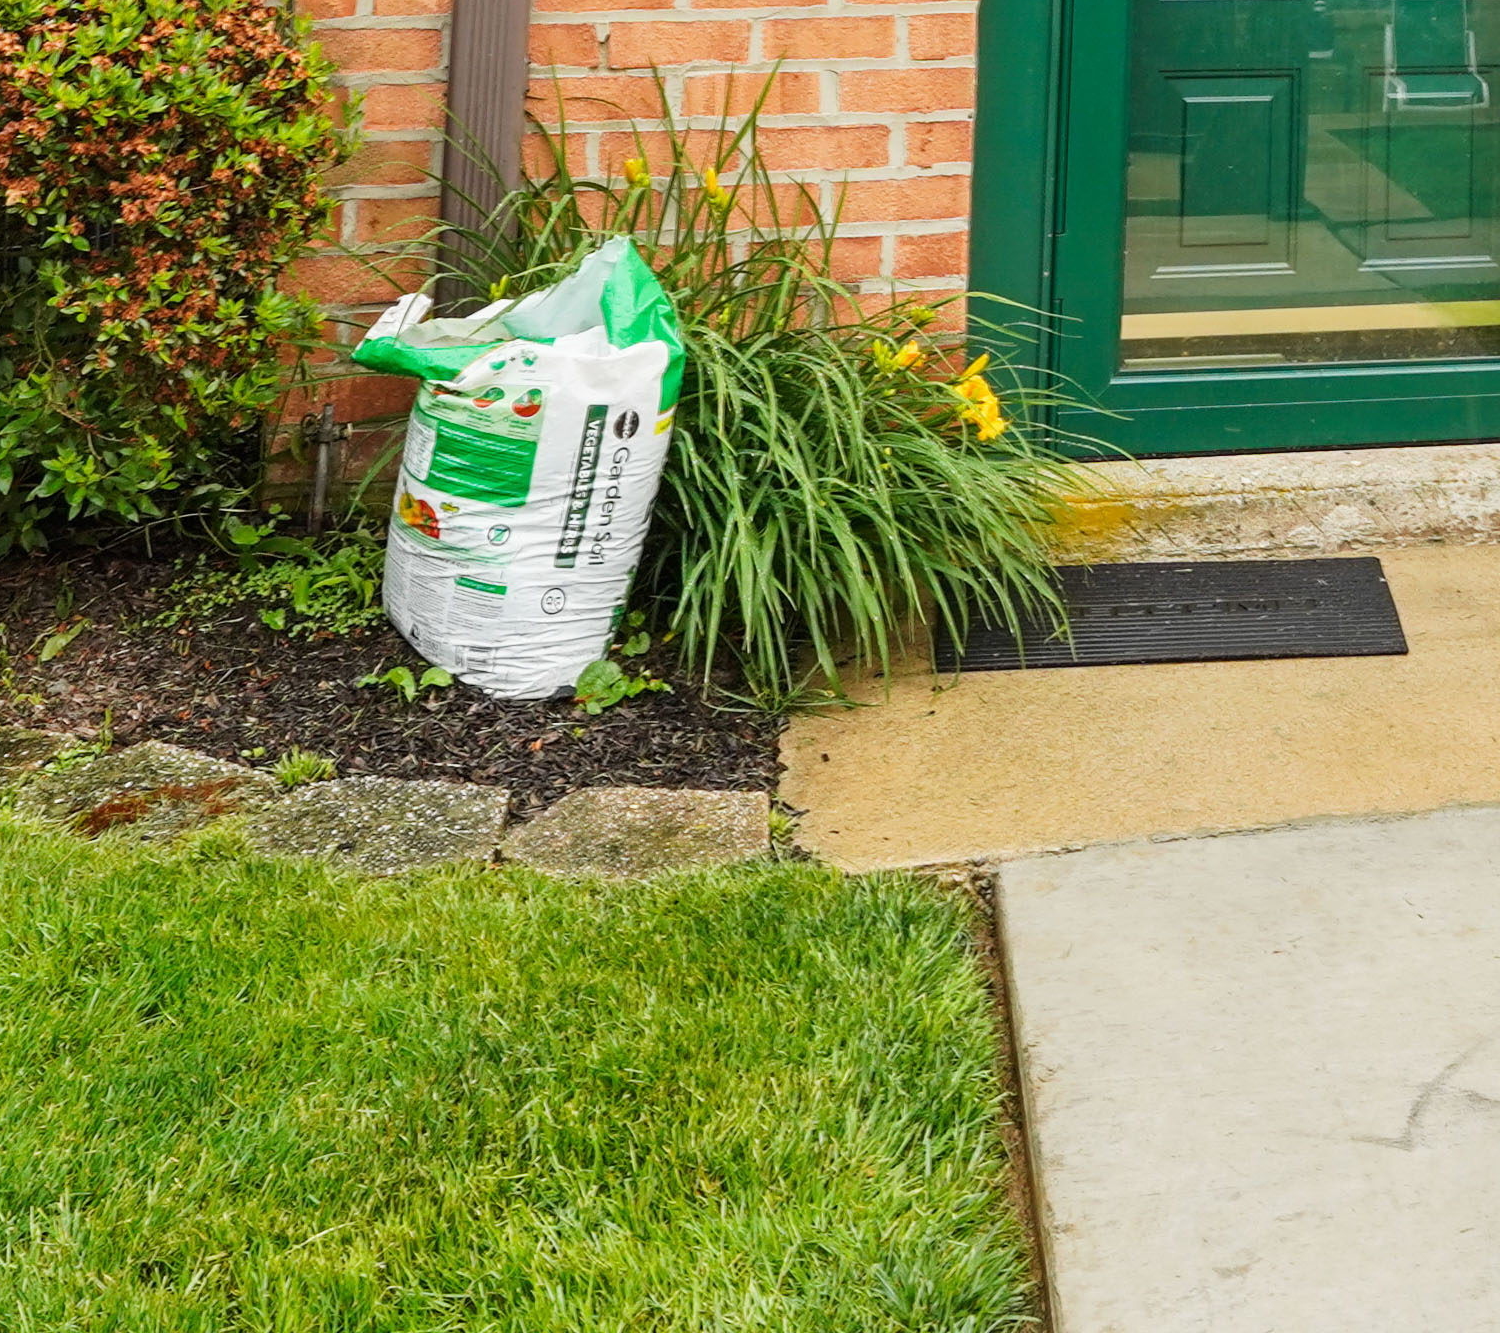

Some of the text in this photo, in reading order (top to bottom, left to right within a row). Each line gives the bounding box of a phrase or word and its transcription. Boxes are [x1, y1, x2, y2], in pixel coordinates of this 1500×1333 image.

[599, 446, 631, 527] Garden
[588, 531, 612, 565] Soil
[1055, 597, 1317, 618] ELCOME
